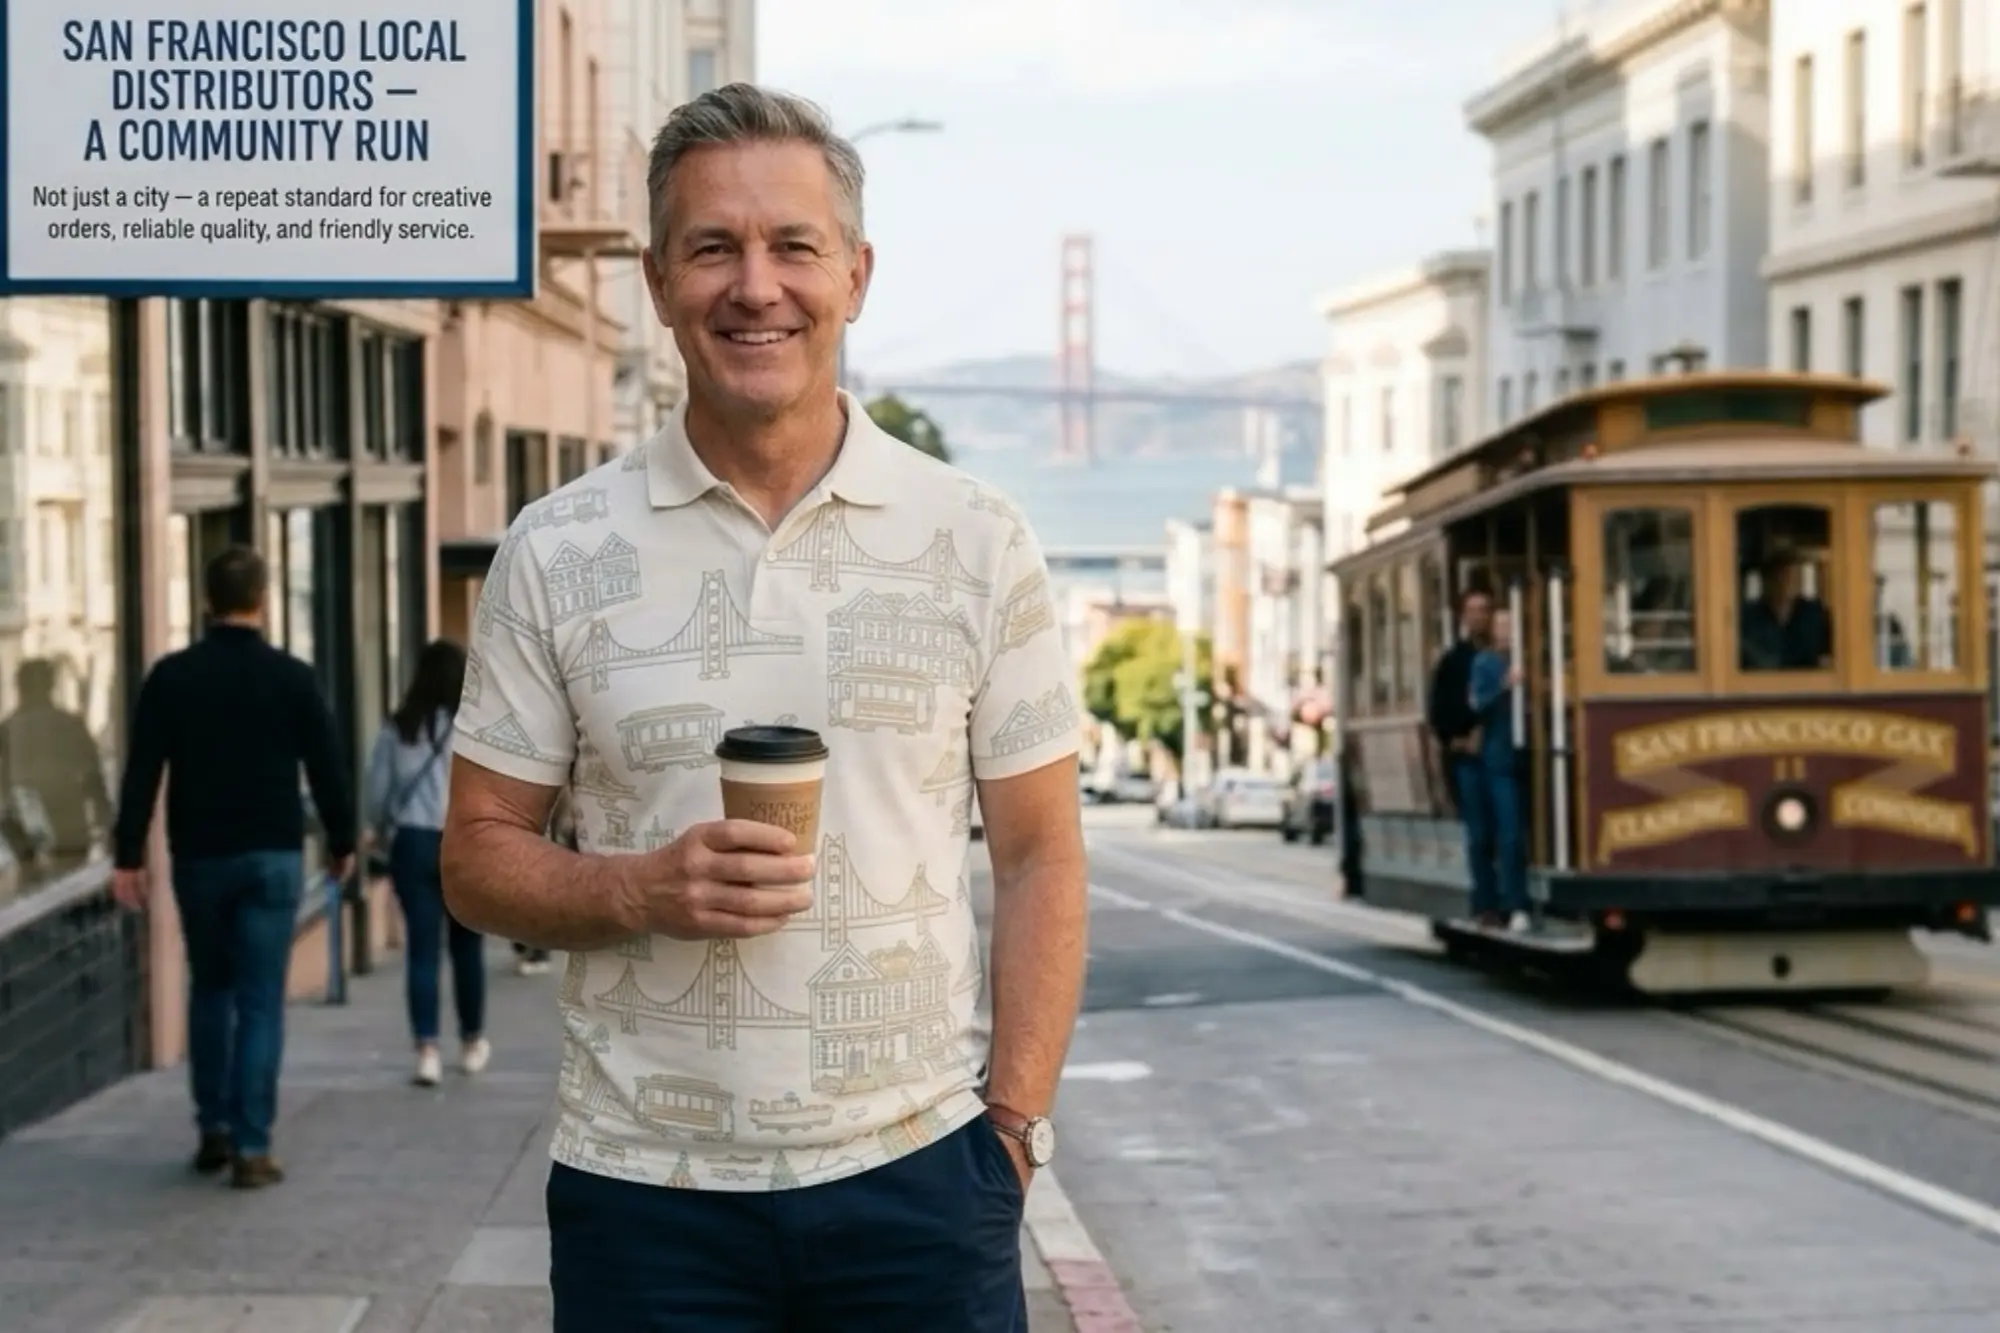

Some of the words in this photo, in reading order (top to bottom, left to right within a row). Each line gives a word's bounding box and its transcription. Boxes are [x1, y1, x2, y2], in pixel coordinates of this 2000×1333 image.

[63, 19, 133, 62] SAN
[147, 19, 346, 63] FRANCISCO
[359, 19, 467, 62] LOCAL
[112, 68, 374, 112] DISTRIBUTORS
[83, 119, 107, 162] A
[119, 118, 344, 162] COMMUNITY
[355, 119, 429, 162] RUN
[33, 185, 68, 207] Not
[72, 185, 110, 212] just
[115, 190, 128, 207] a
[133, 185, 170, 212] city
[197, 190, 210, 208] a
[215, 187, 279, 212] repeat
[284, 186, 373, 208] standard
[379, 185, 407, 207] for
[412, 185, 492, 208] creative
[48, 218, 116, 241] orders,
[123, 218, 195, 239] reliable
[200, 217, 271, 244] quality,
[276, 219, 313, 240] and
[319, 217, 393, 245] friendly
[398, 219, 475, 240] service.
[1625, 730, 1690, 765] SAN
[1696, 717, 1876, 753] FRANCISCO
